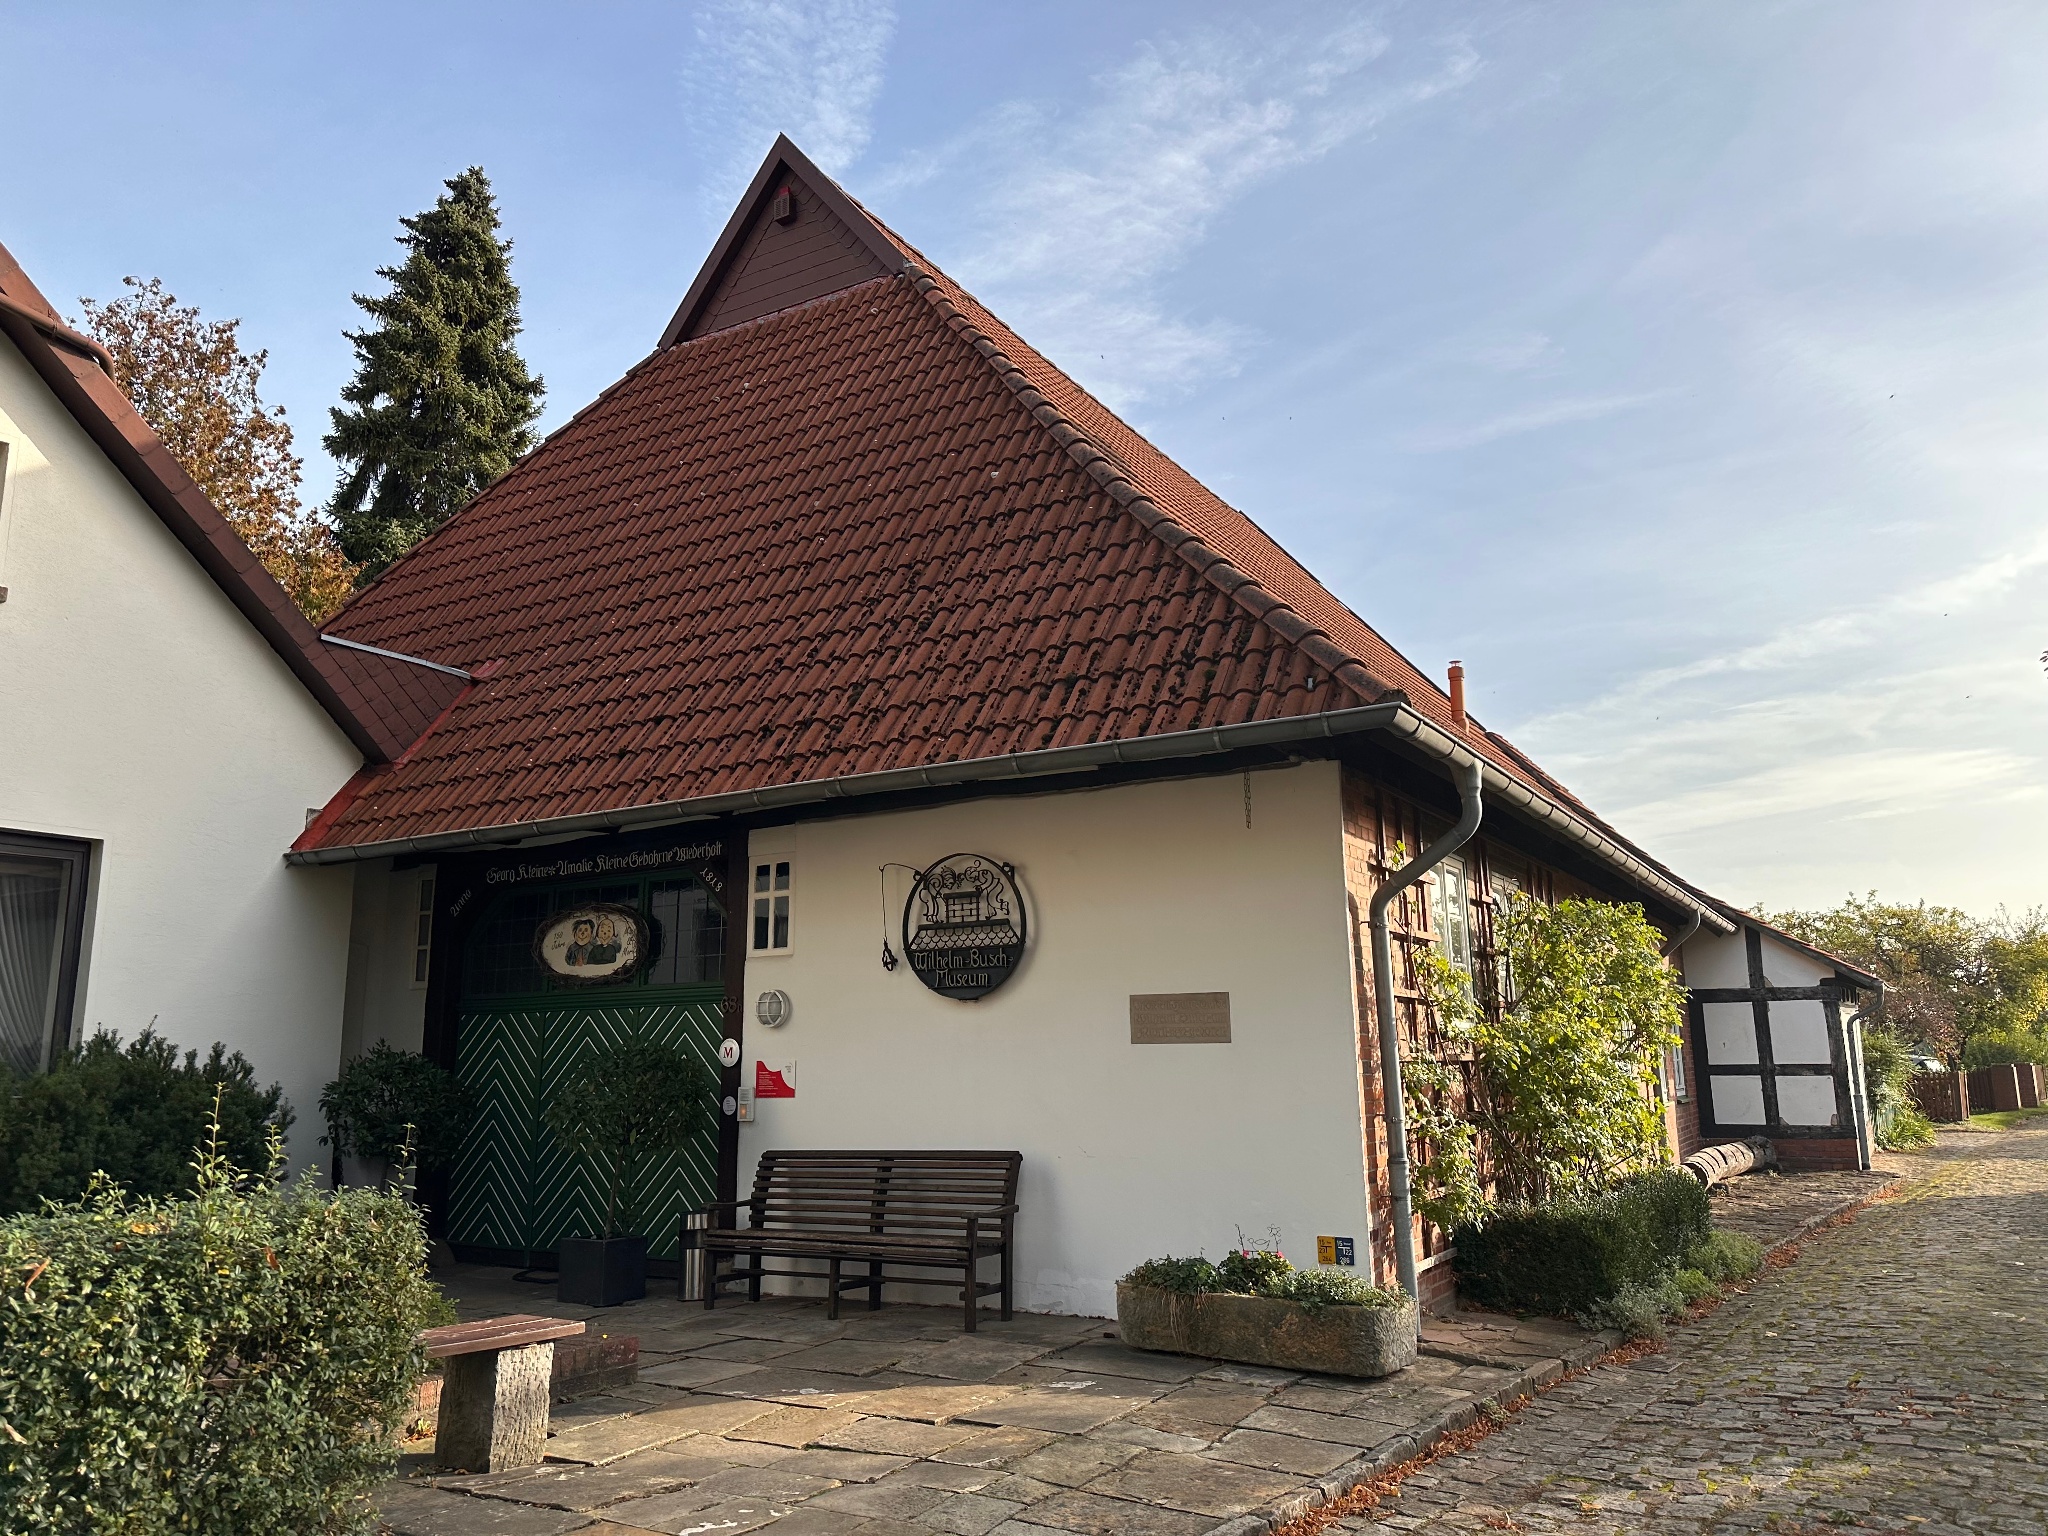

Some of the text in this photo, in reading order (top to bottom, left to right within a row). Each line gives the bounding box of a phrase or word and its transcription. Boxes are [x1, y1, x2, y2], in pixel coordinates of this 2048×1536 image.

[486, 867, 515, 884] Georg
[517, 863, 548, 881] Kleine
[556, 858, 593, 876] Amalie
[595, 854, 629, 873] Kleine
[672, 840, 723, 861] Wiederholt
[935, 968, 988, 987] Museum
[723, 1046, 733, 1059] M
